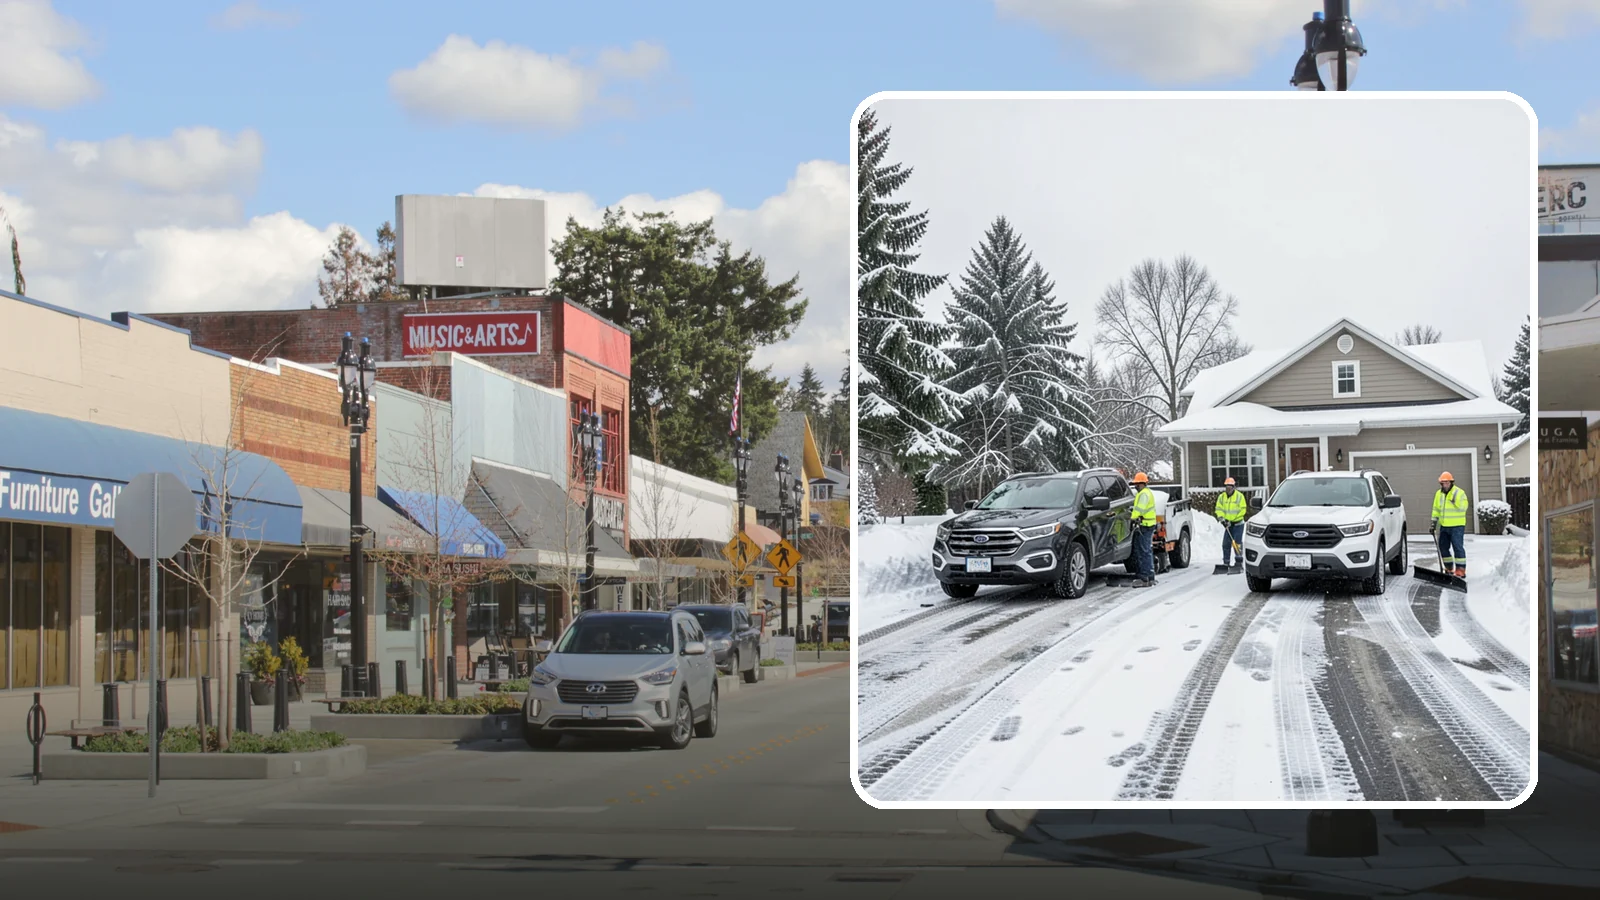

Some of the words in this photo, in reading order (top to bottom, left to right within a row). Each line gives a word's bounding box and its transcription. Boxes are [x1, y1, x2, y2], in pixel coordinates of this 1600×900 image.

[409, 323, 520, 348] MUSIC&ARTS
[1540, 427, 1577, 436] UGA
[0, 471, 79, 515] Furniture
[89, 482, 121, 519] Gal
[454, 563, 479, 574] SUSHI
